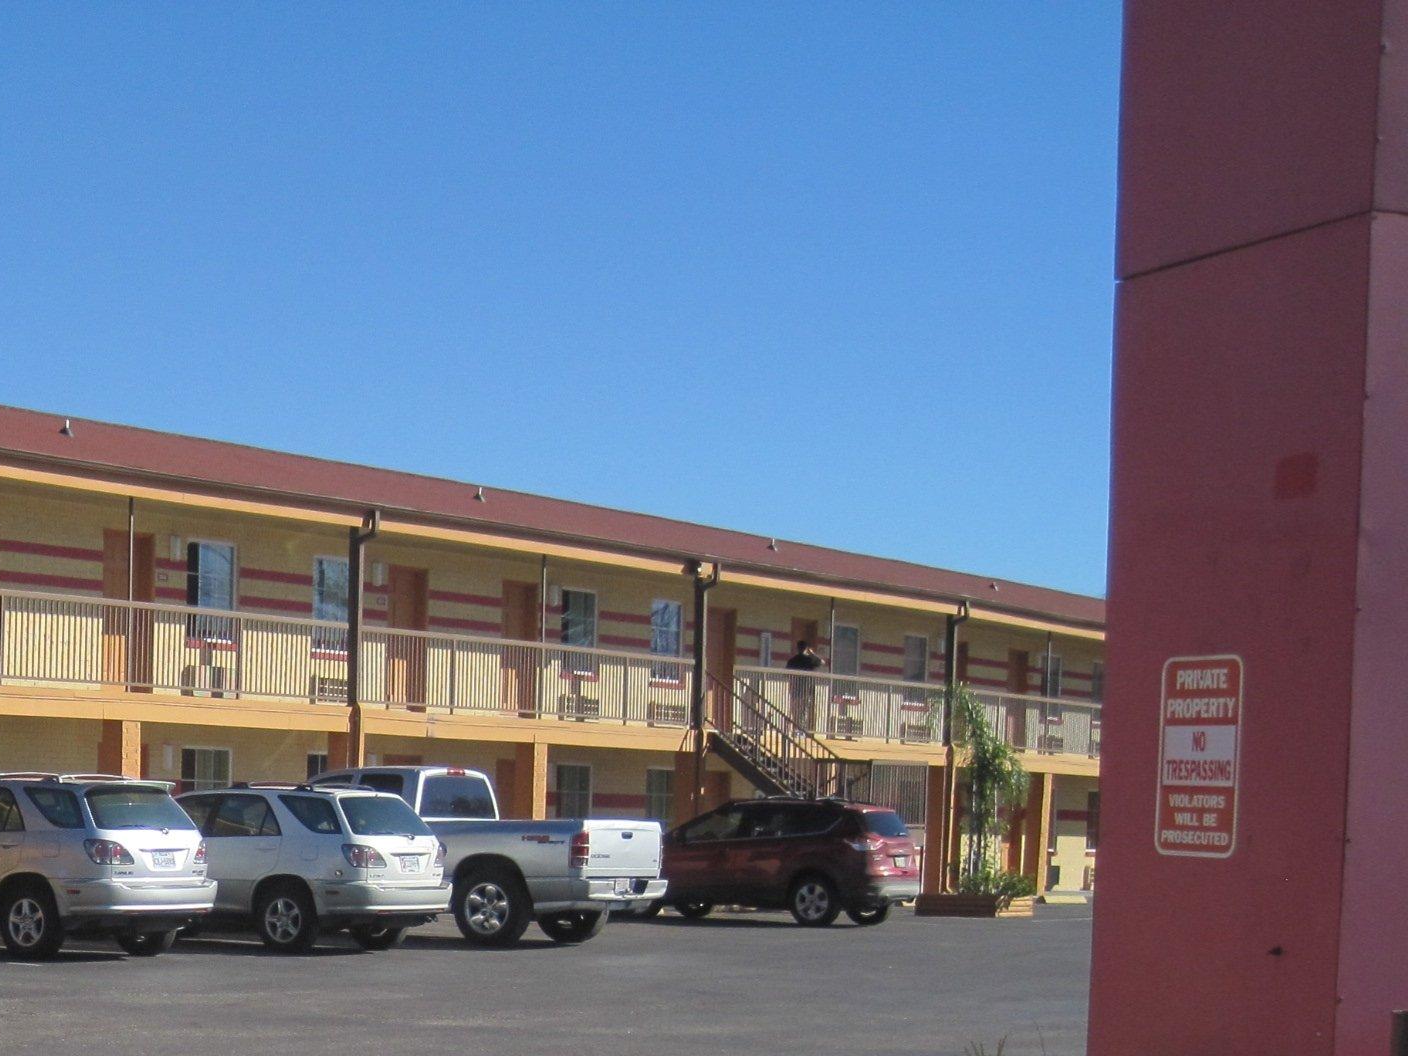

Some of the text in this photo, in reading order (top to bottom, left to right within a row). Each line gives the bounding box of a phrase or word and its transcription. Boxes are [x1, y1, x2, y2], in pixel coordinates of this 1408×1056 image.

[1177, 669, 1228, 690] PRIVATE
[1167, 698, 1235, 718] PROPERTY
[1192, 731, 1206, 751] NO
[1166, 760, 1231, 781] TRESPASSING
[1169, 794, 1225, 808] VIOLATORS
[1175, 813, 1217, 826] WILL BE
[1161, 831, 1228, 845] PROSECUTED
